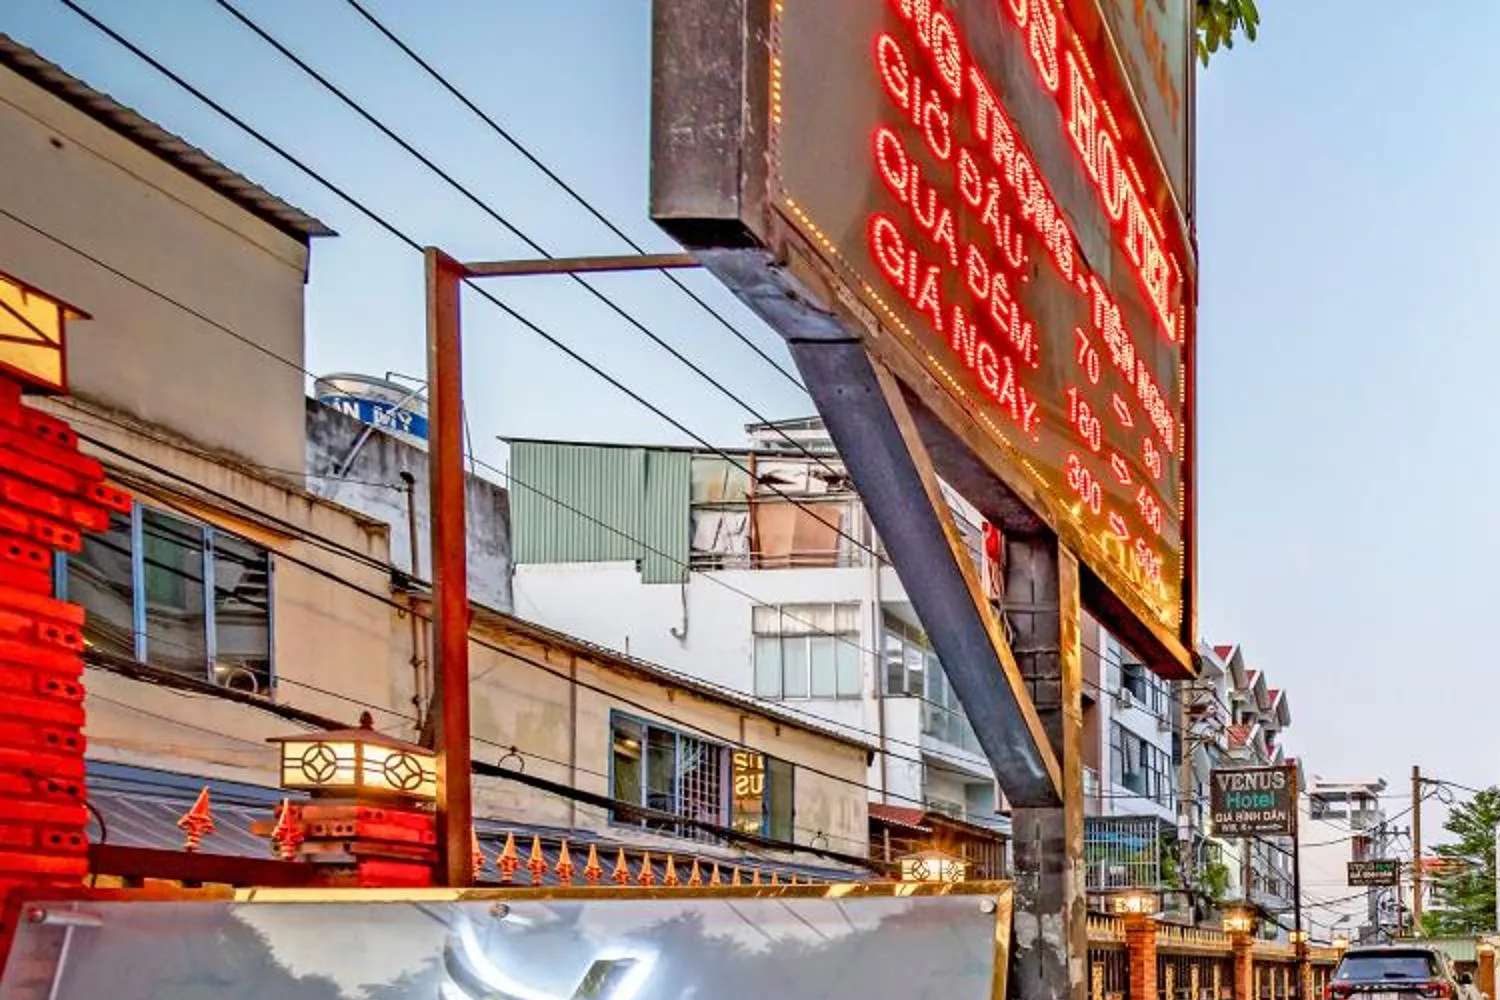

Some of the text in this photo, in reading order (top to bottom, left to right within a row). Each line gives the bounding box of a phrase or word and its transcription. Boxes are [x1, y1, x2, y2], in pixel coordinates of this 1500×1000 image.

[1065, 50, 1176, 342] HOTEL
[876, 128, 959, 267] QUA
[1067, 387, 1101, 452] 180
[1076, 327, 1100, 385] 70
[1068, 454, 1101, 516] 300
[1215, 771, 1285, 791] VENUS
[1227, 792, 1275, 809] Hotel
